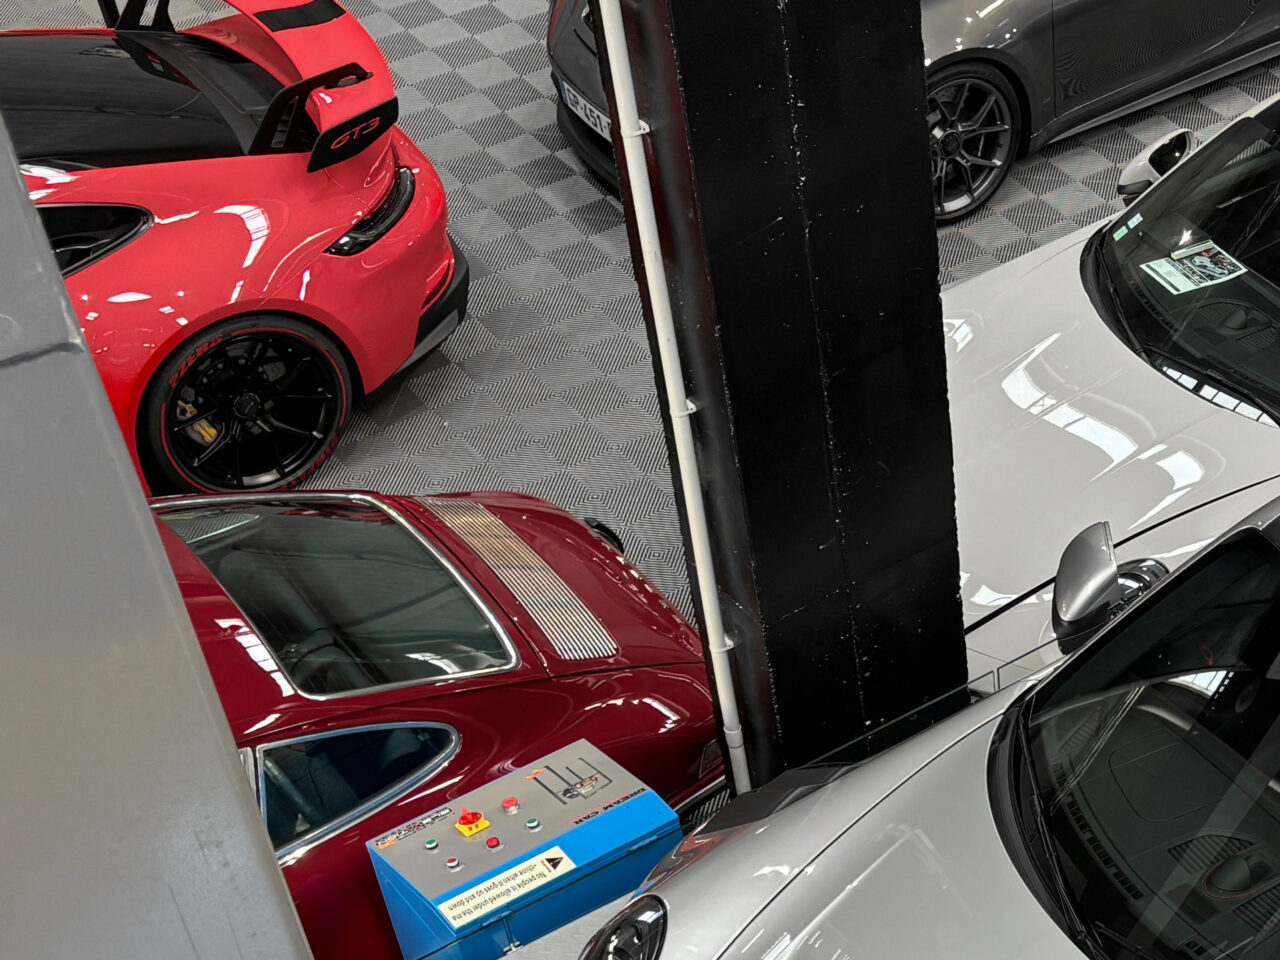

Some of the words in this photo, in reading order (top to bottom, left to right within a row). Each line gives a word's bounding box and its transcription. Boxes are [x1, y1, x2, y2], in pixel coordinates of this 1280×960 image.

[330, 117, 380, 149] GT3
[503, 872, 518, 884] when
[516, 873, 536, 888] people
[483, 881, 498, 893] goes
[464, 892, 476, 904] and
[489, 887, 512, 903] allowed
[447, 899, 465, 911] down
[473, 898, 489, 910] under
[461, 907, 474, 916] the
